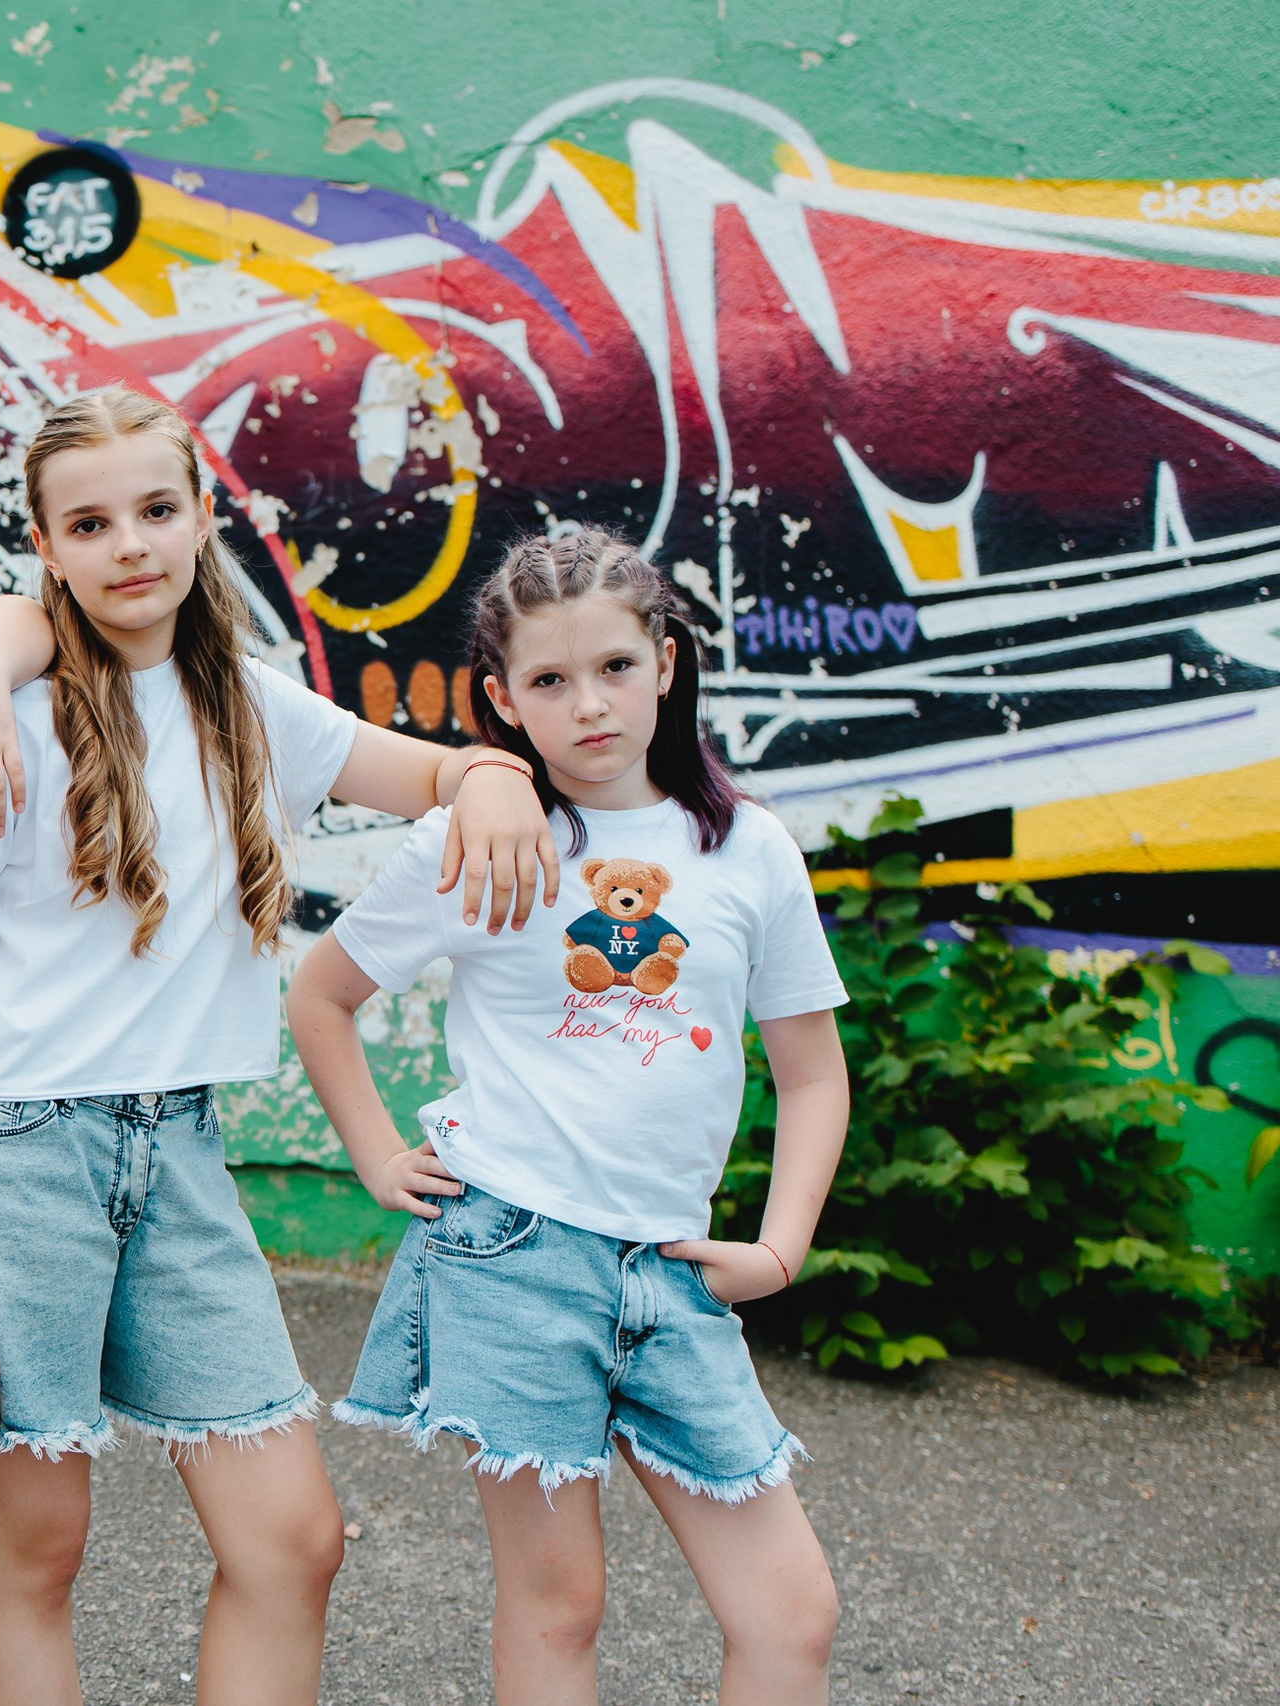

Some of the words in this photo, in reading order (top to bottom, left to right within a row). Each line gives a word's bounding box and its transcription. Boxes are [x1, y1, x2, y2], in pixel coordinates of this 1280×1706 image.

[25, 177, 110, 216] FAT
[563, 991, 630, 1010] new
[624, 991, 692, 1024] york
[547, 1010, 622, 1039] has
[622, 1026, 682, 1067] my
